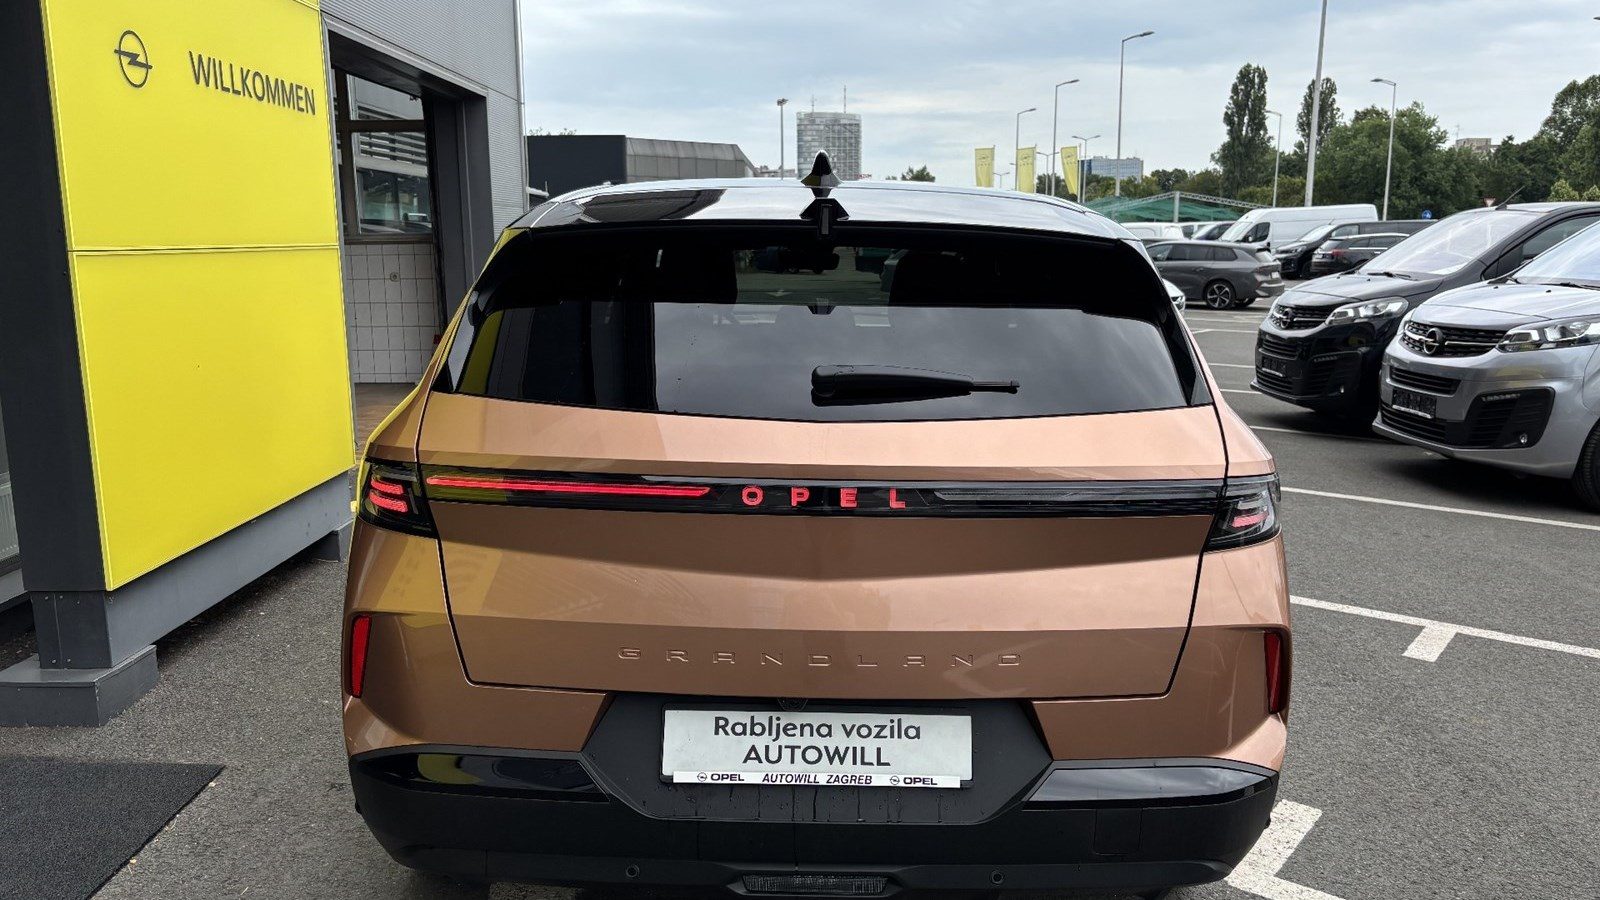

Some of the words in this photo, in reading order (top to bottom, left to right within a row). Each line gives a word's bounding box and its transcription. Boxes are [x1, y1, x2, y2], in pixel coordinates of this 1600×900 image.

[188, 50, 316, 115] WILLKOMMEN
[741, 486, 906, 509] OPEL
[617, 646, 1022, 669] GRANDLAND
[714, 716, 833, 742] Rabljena
[842, 718, 921, 740] vozila
[742, 745, 891, 766] AUTOWILL
[710, 774, 745, 782] OPEL
[762, 774, 820, 784] AUTOWILL
[826, 775, 872, 785] ZAGREB
[903, 777, 938, 786] OPEL
